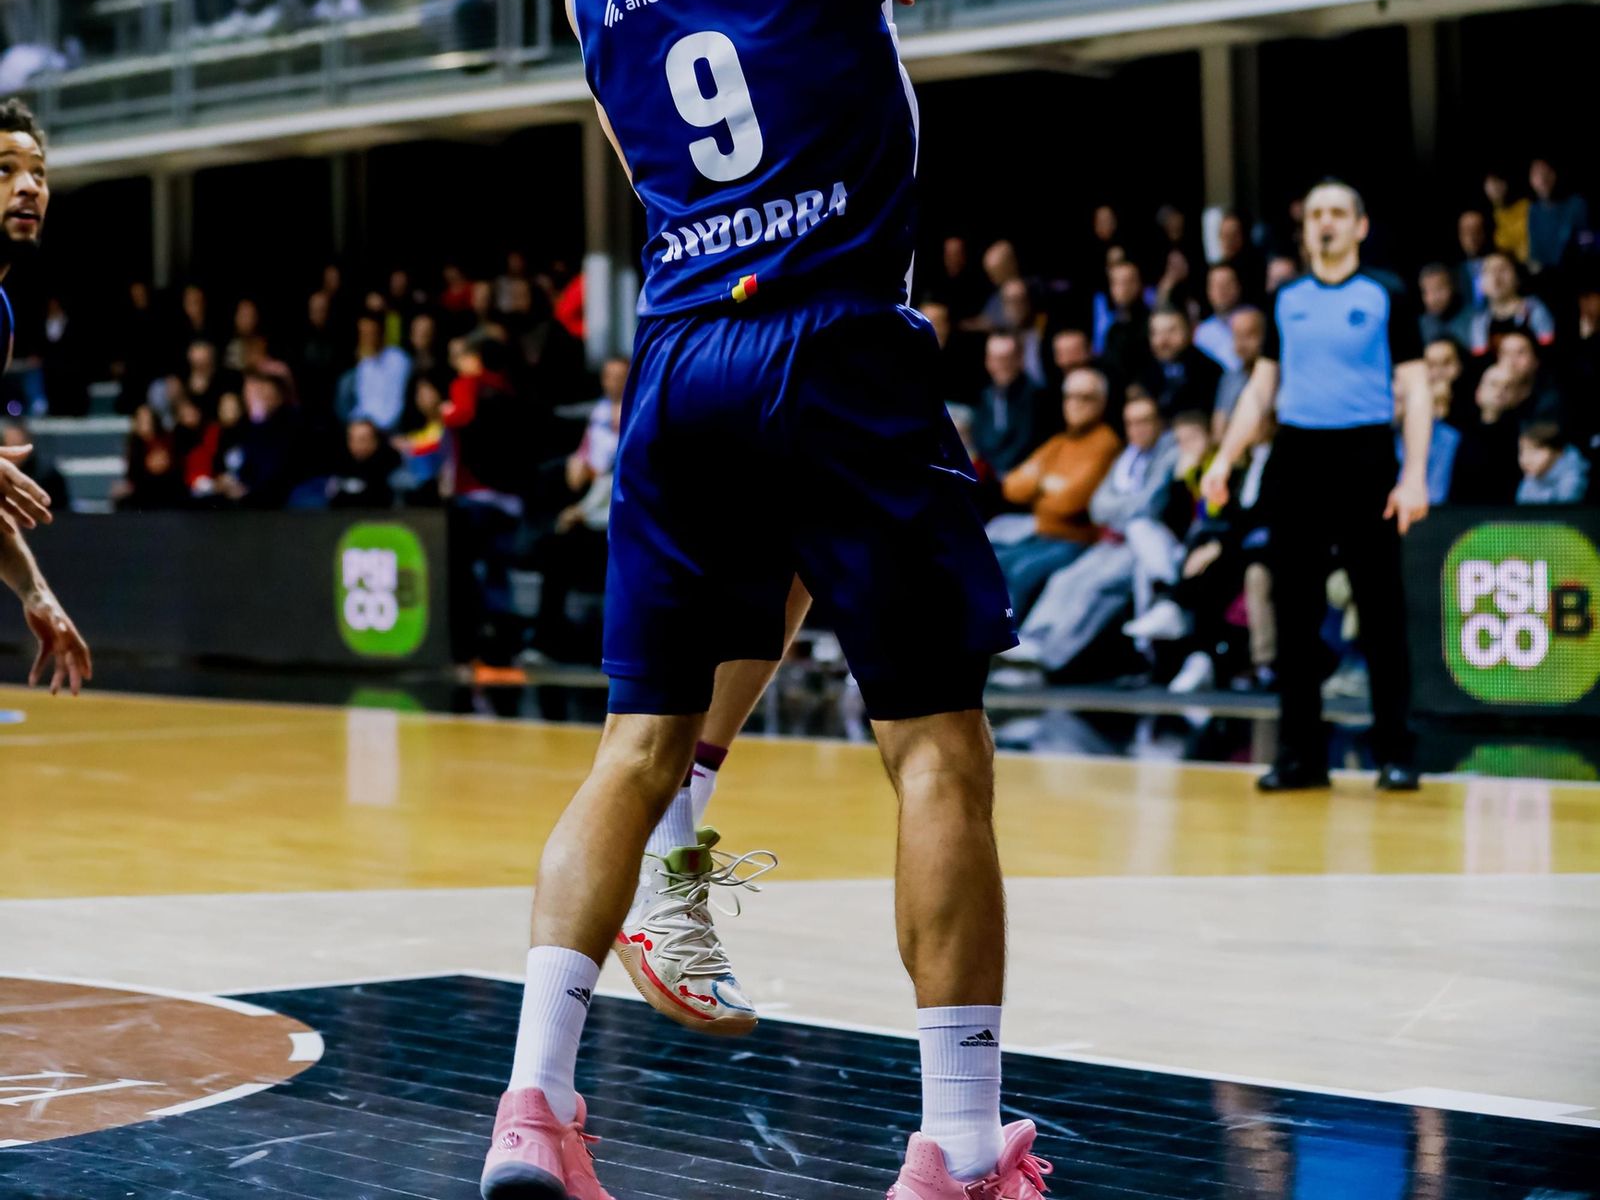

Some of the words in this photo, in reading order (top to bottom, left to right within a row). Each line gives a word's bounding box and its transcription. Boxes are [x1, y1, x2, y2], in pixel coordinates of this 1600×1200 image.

[665, 30, 764, 182] 9
[661, 181, 848, 264] ANDORRA
[1458, 559, 1549, 615] PSI
[1460, 613, 1550, 669] CO
